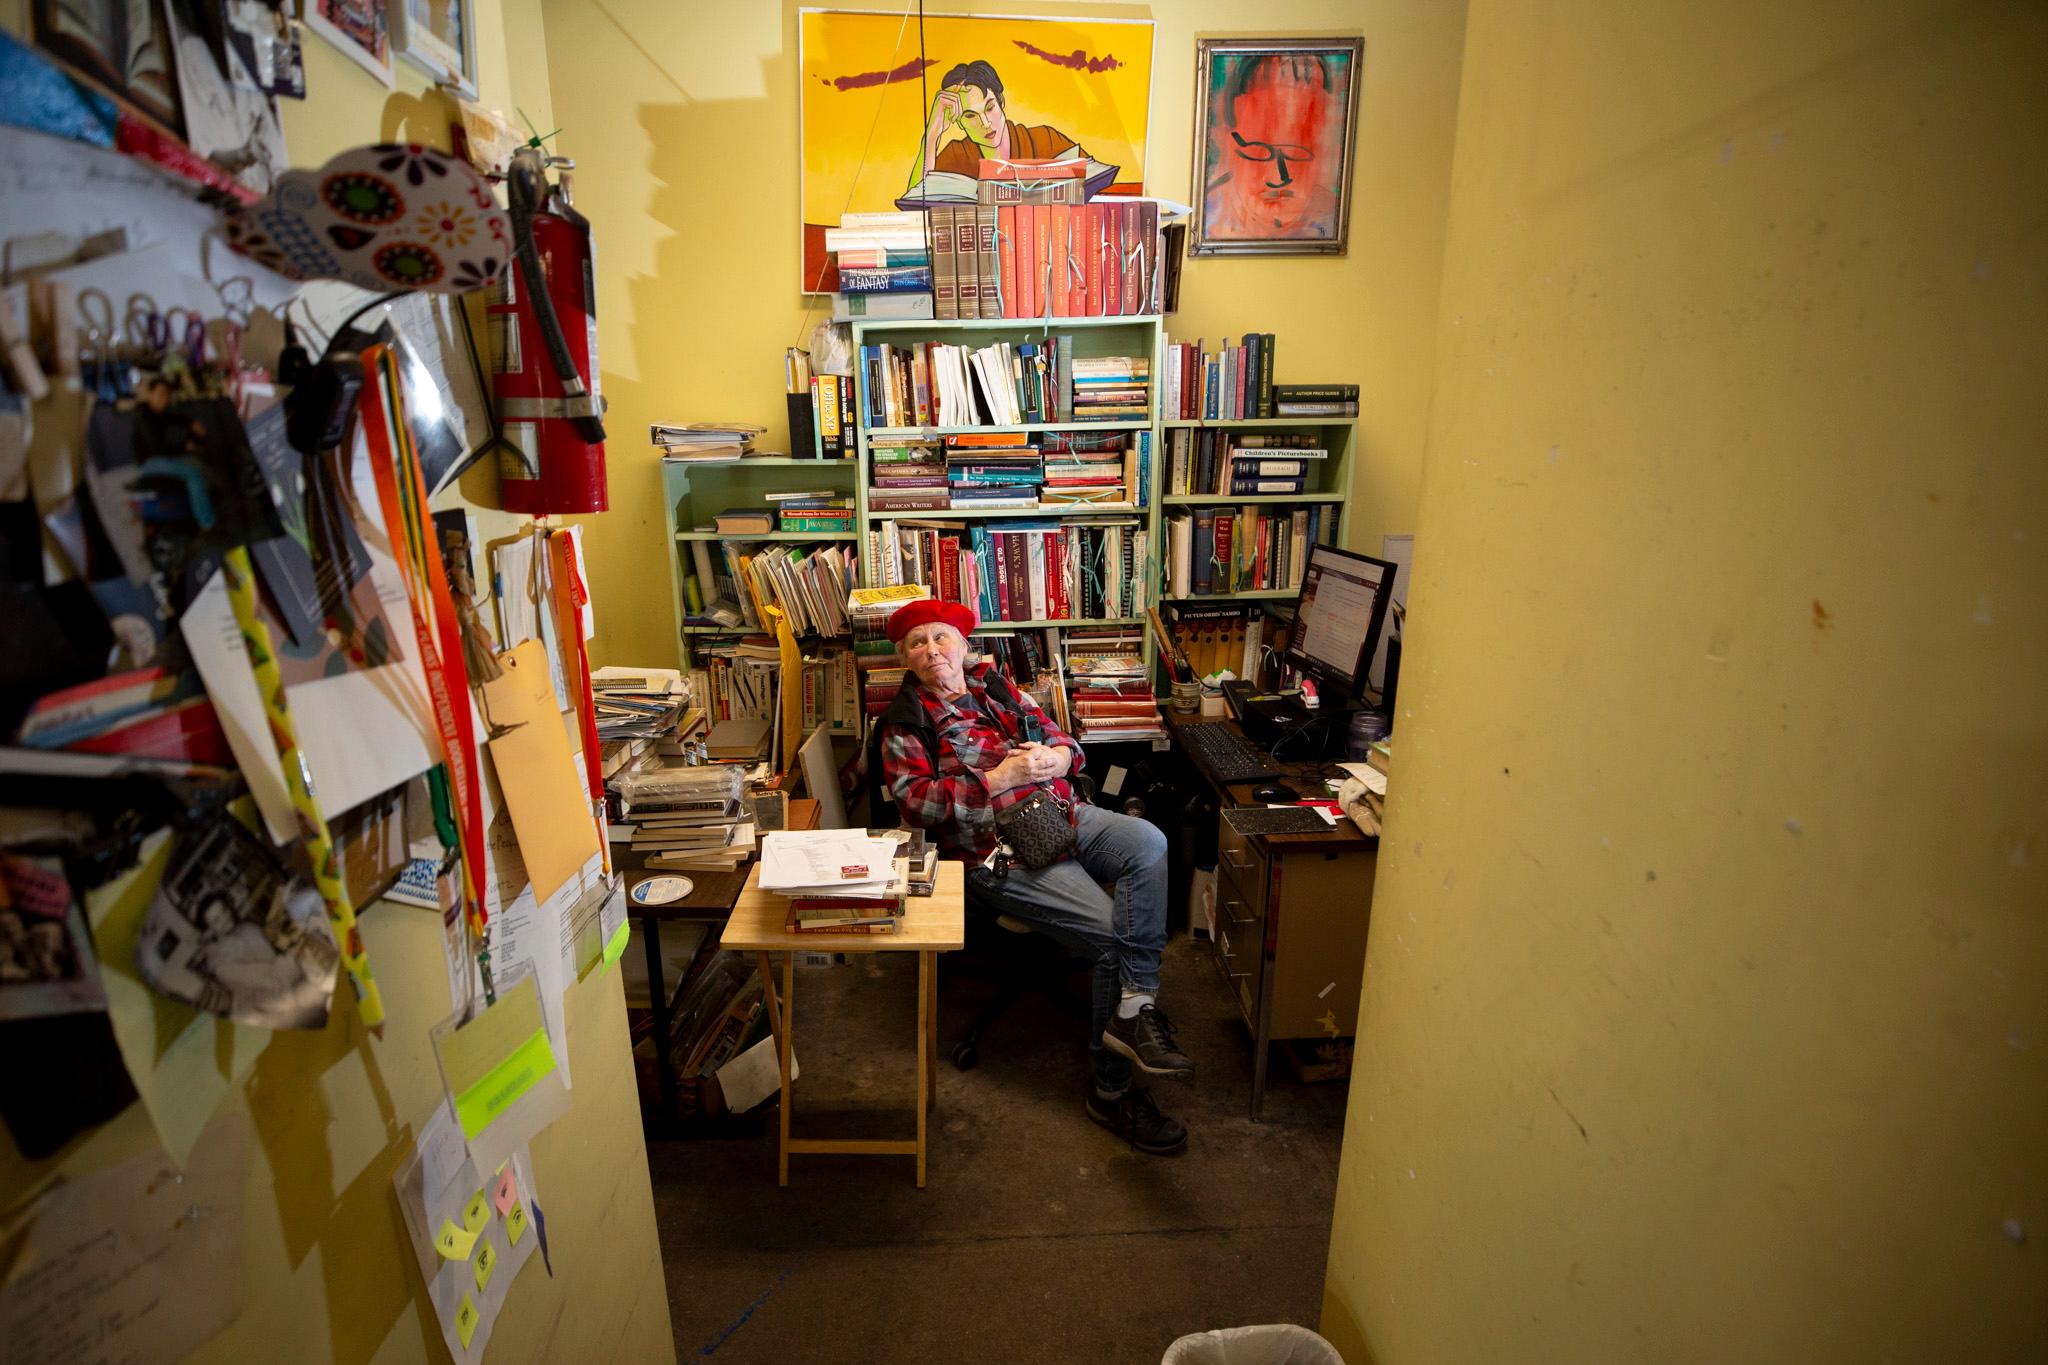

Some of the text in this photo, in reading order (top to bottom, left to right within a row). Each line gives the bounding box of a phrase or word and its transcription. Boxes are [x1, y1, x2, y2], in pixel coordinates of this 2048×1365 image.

[857, 275, 890, 290] FANTASY
[823, 386, 836, 432] Office XP
[803, 518, 822, 531] JAVA
[1012, 535, 1021, 569] HAWK's
[943, 556, 953, 597] Literature
[429, 670, 458, 738] INDEPENDENT
